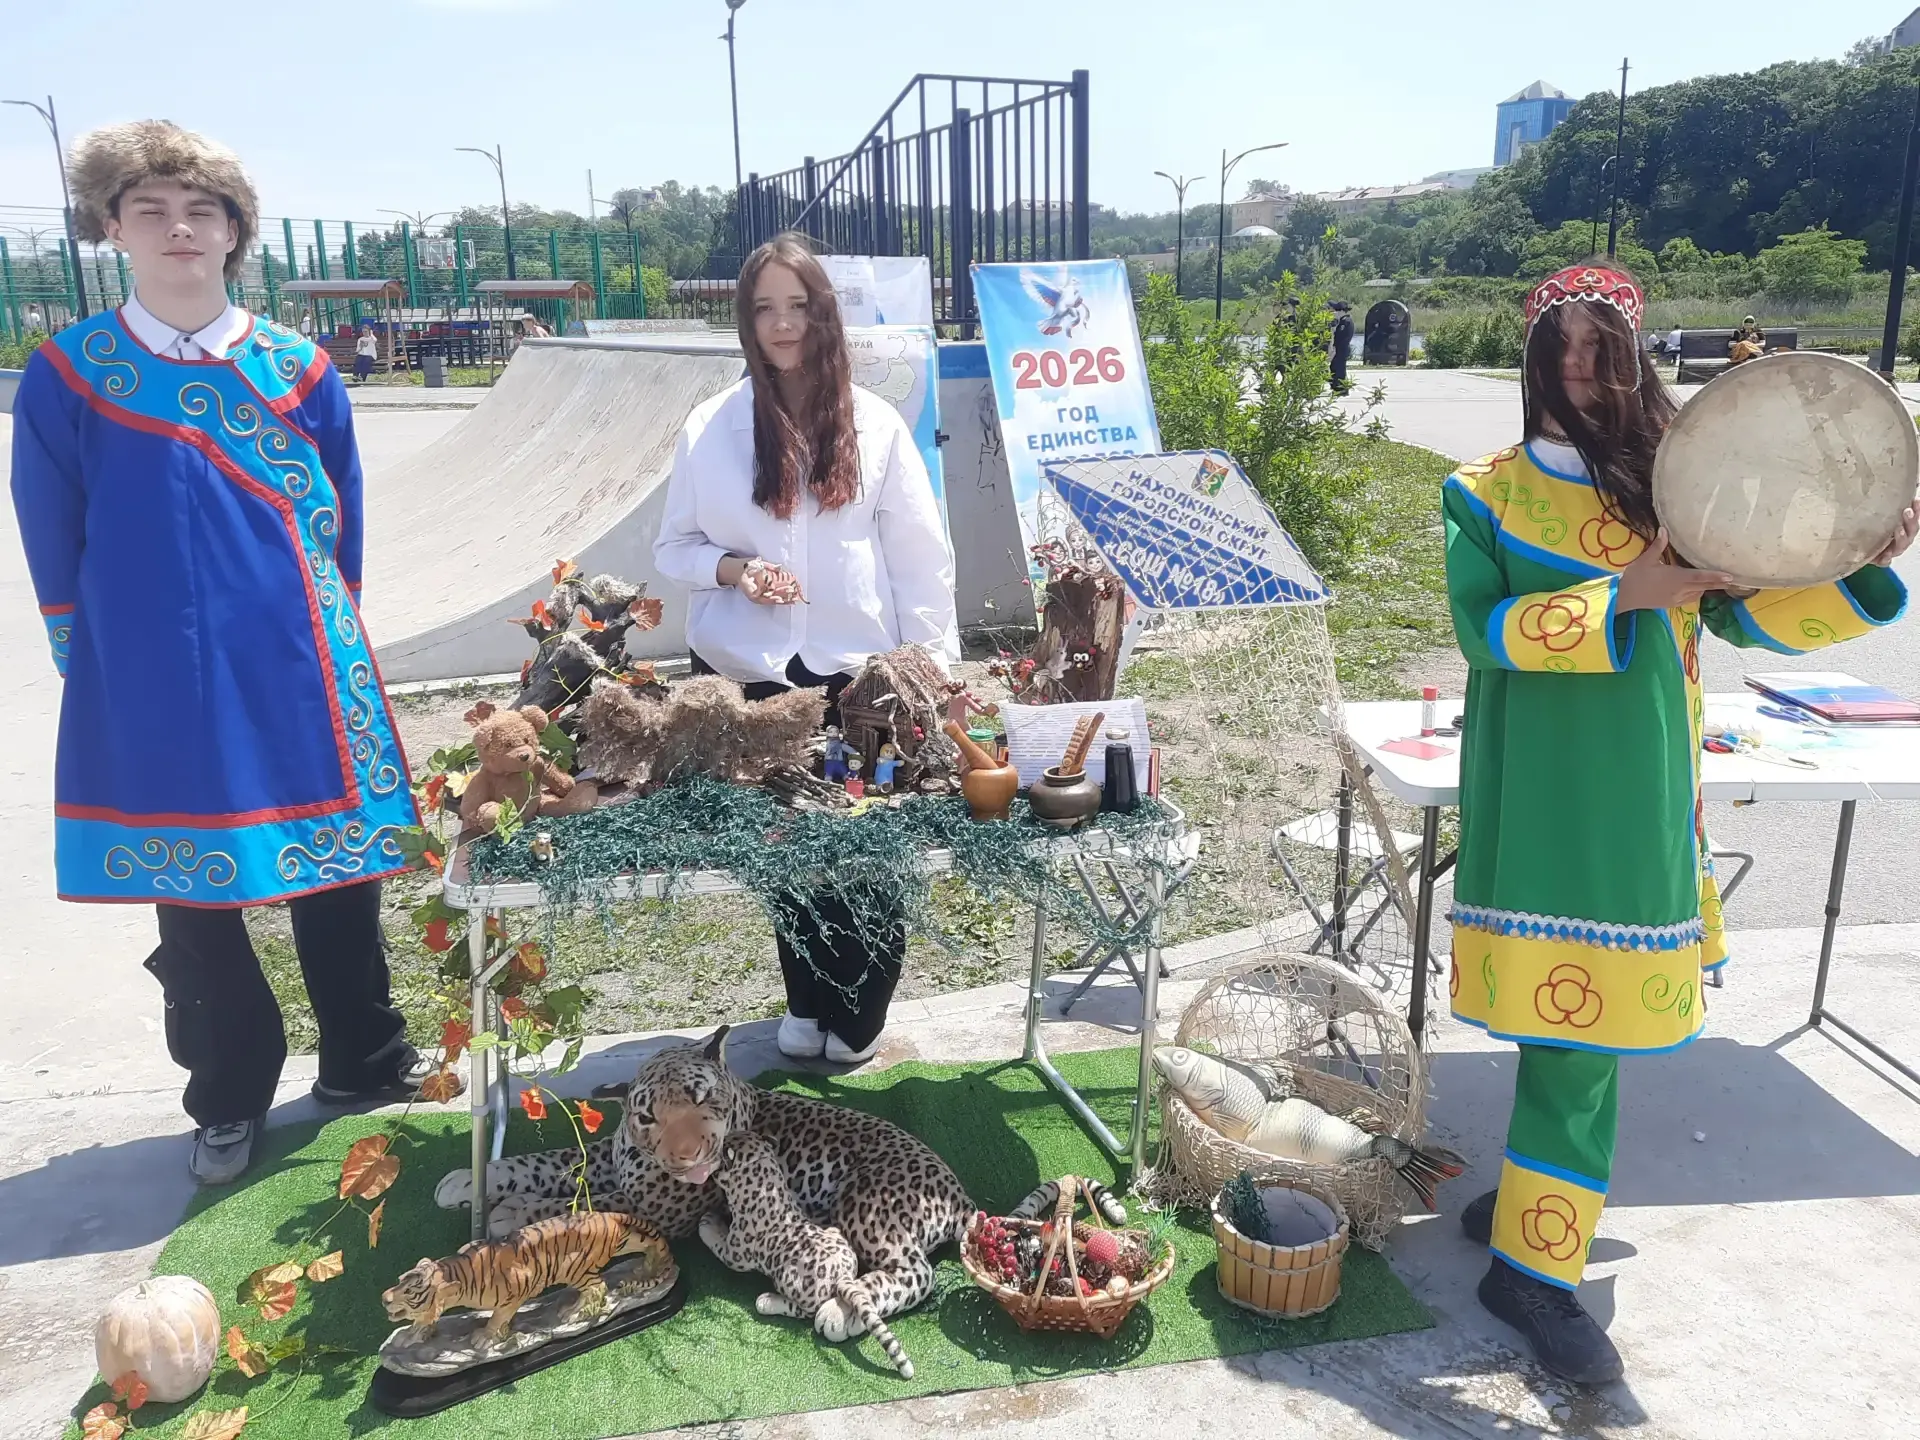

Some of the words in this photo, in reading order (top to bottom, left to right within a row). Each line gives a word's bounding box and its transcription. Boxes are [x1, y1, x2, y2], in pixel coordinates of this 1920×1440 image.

[1012, 346, 1125, 389] 2026
[1057, 405, 1100, 424] ГОД
[1027, 426, 1138, 452] ЕДИНСТВА
[1110, 481, 1214, 535] ГОРОДСКОЙ
[1217, 531, 1271, 561] ОКРУГ
[1129, 470, 1269, 540] НАХОДКИНСКИЙ
